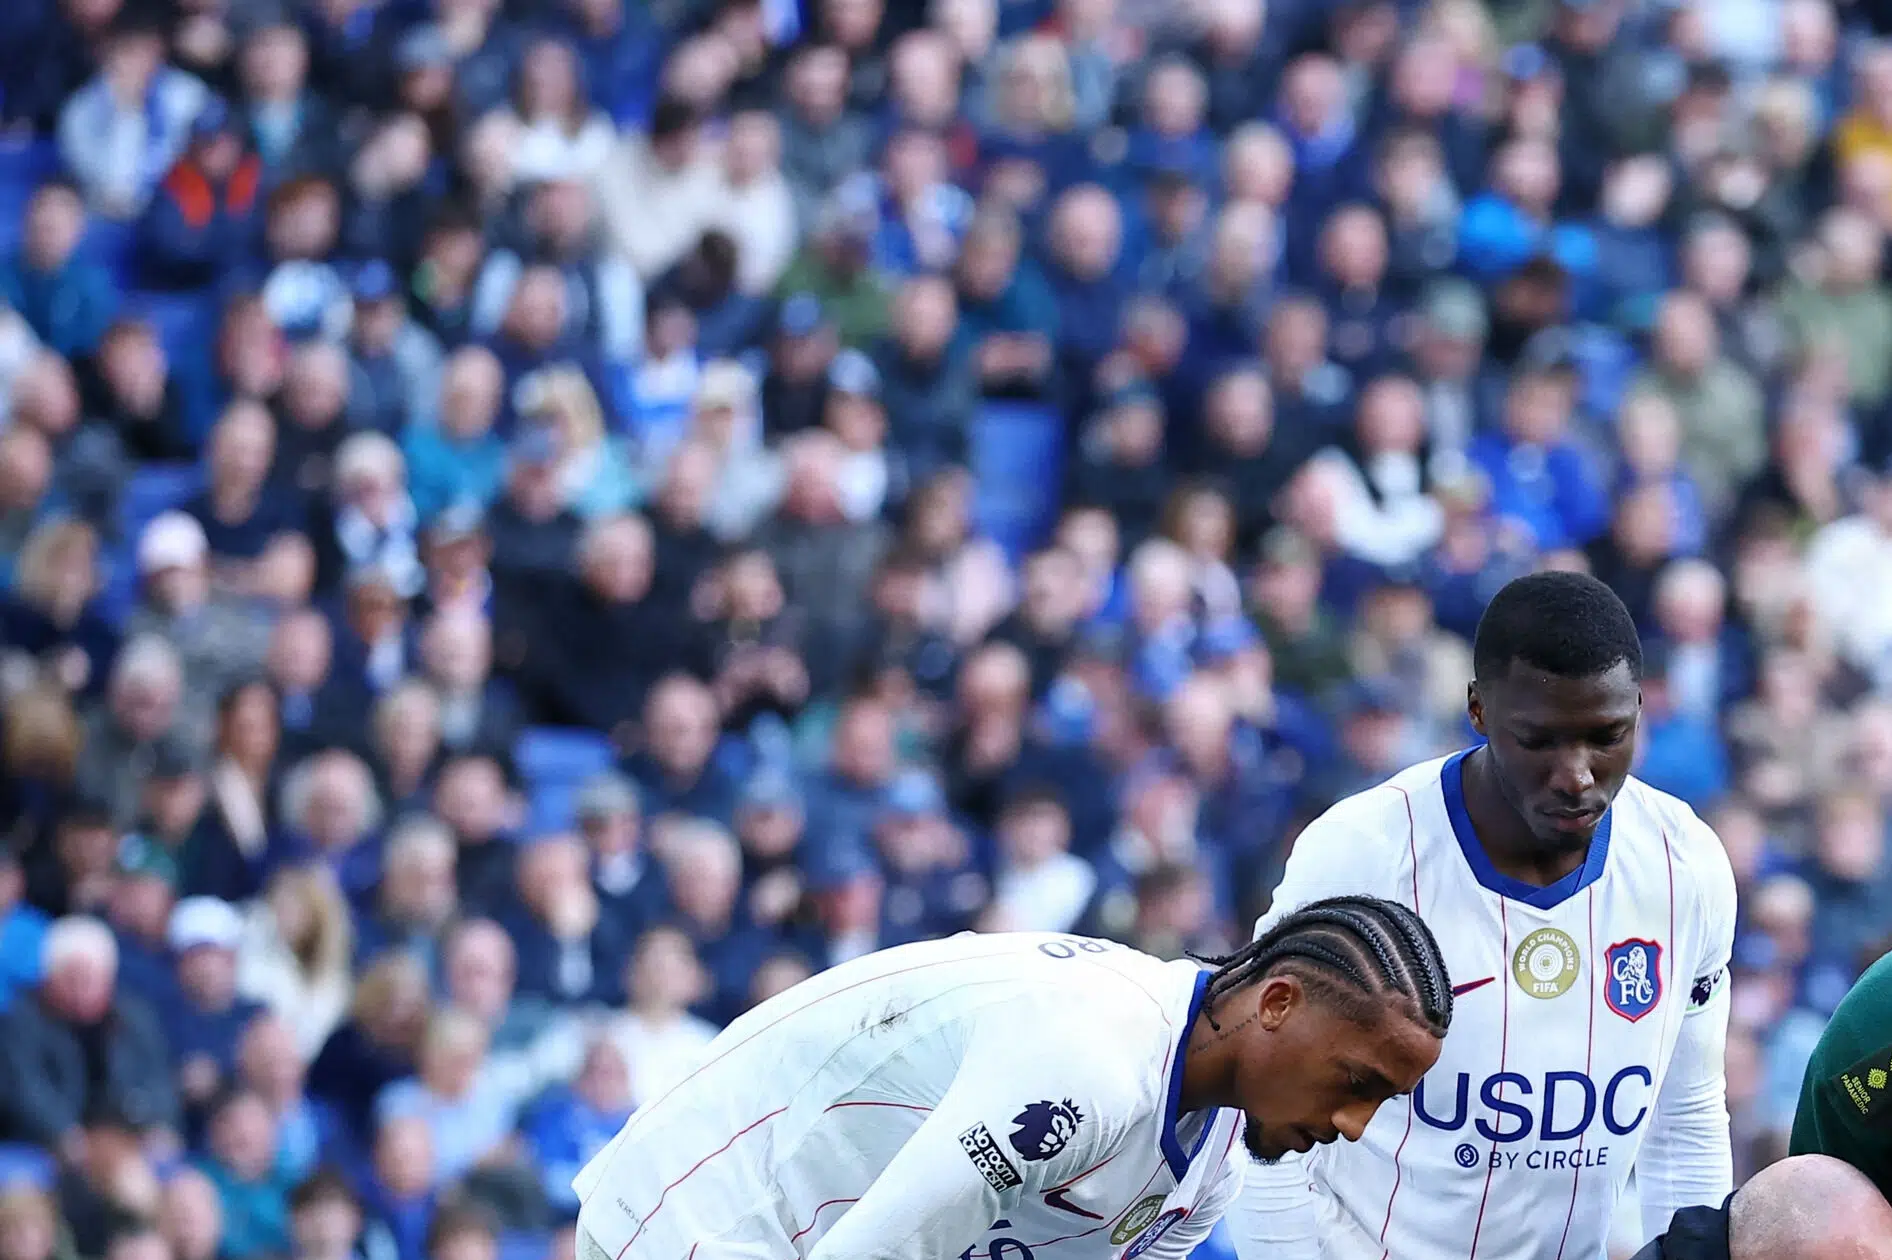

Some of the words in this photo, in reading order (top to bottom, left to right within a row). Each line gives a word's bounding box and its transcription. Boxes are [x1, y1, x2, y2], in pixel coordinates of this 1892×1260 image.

[1518, 939, 1537, 972] WORLD
[1537, 932, 1575, 970] CHAMPIONS
[1532, 981, 1559, 993] FIFA
[1413, 1065, 1652, 1143] USDC
[1840, 1073, 1869, 1115] PARAMEDIC
[1851, 1076, 1871, 1104] SENIOR
[983, 1145, 1016, 1182] room
[1488, 1151, 1520, 1170] BY
[1525, 1147, 1609, 1170] CIRCLE
